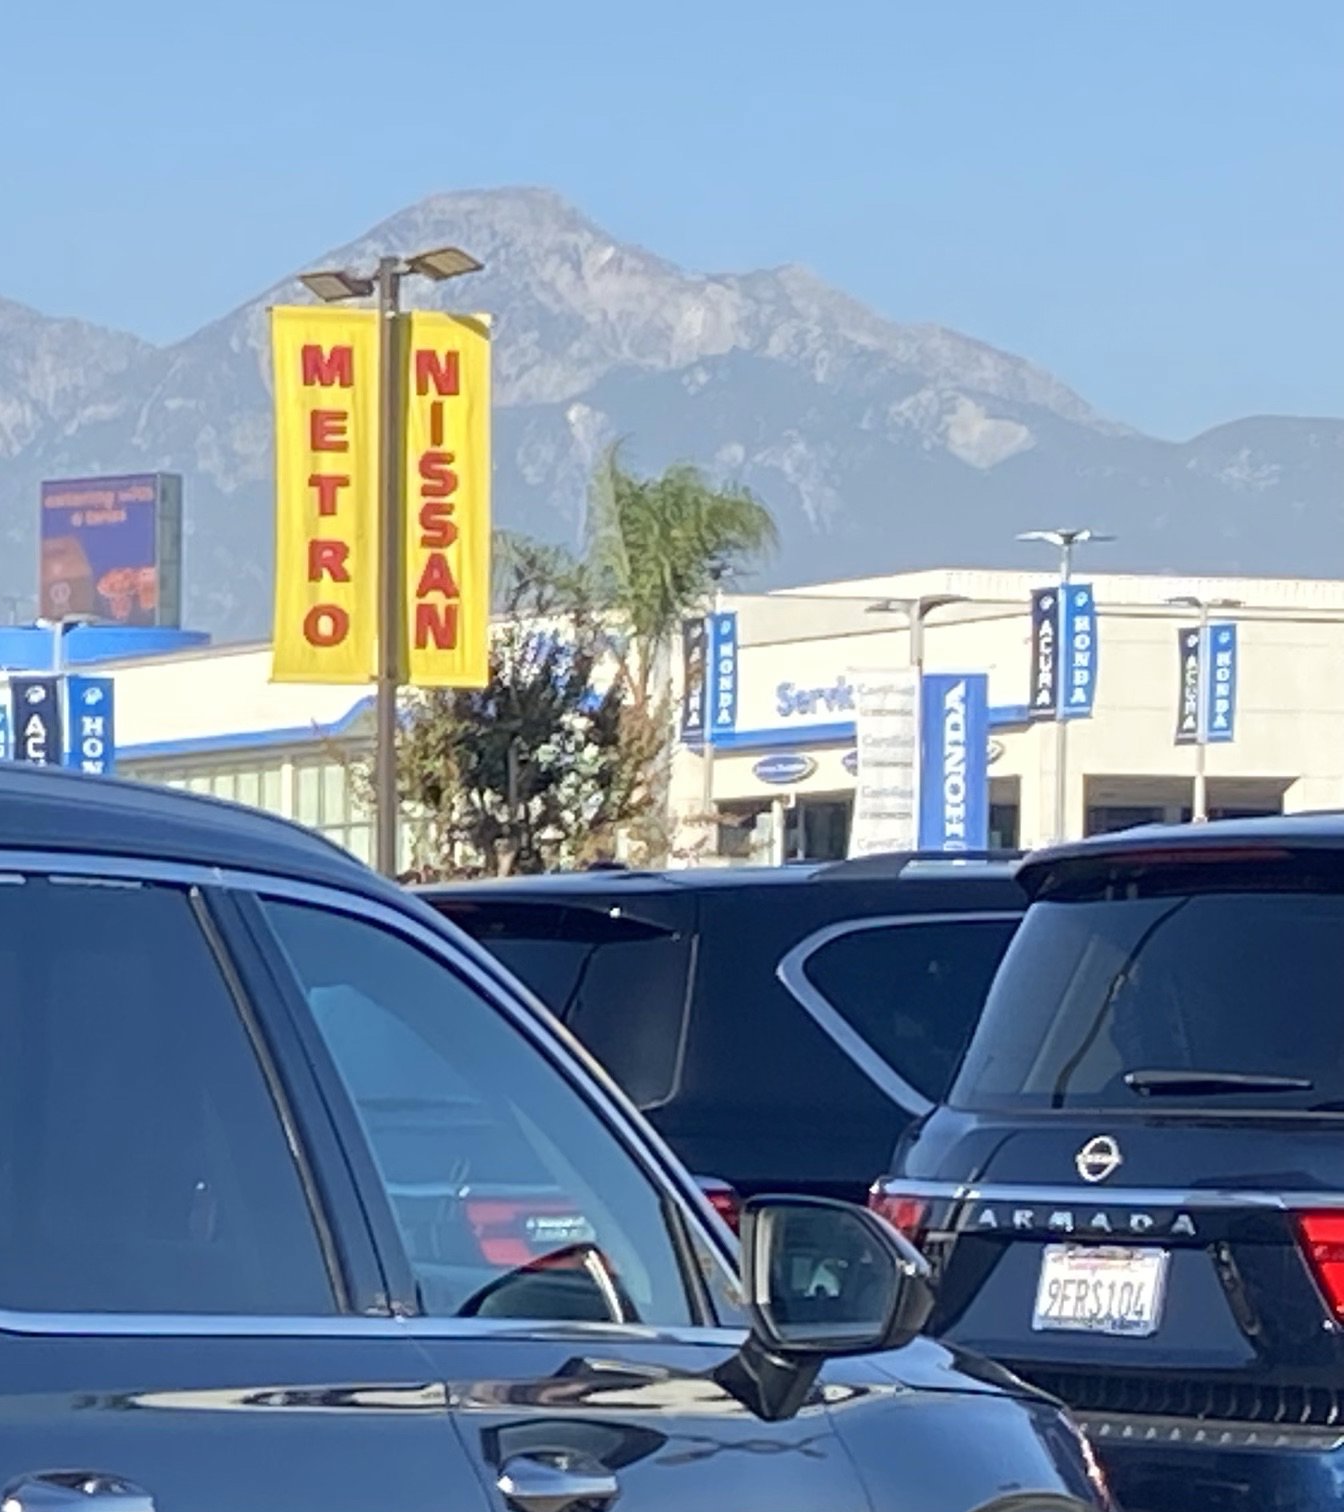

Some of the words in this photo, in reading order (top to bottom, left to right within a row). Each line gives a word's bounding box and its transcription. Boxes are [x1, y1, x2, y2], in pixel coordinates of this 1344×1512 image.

[301, 344, 354, 649] METRO
[414, 348, 460, 651] NISSAN
[717, 642, 735, 725] HONDA
[1036, 619, 1054, 706] ACURA
[1070, 616, 1091, 704] HONDA
[1213, 651, 1231, 729] HONDA
[943, 680, 966, 838] HONDA
[977, 1208, 1197, 1237] ARMADA
[1044, 1278, 1145, 1318] 9FRS104
